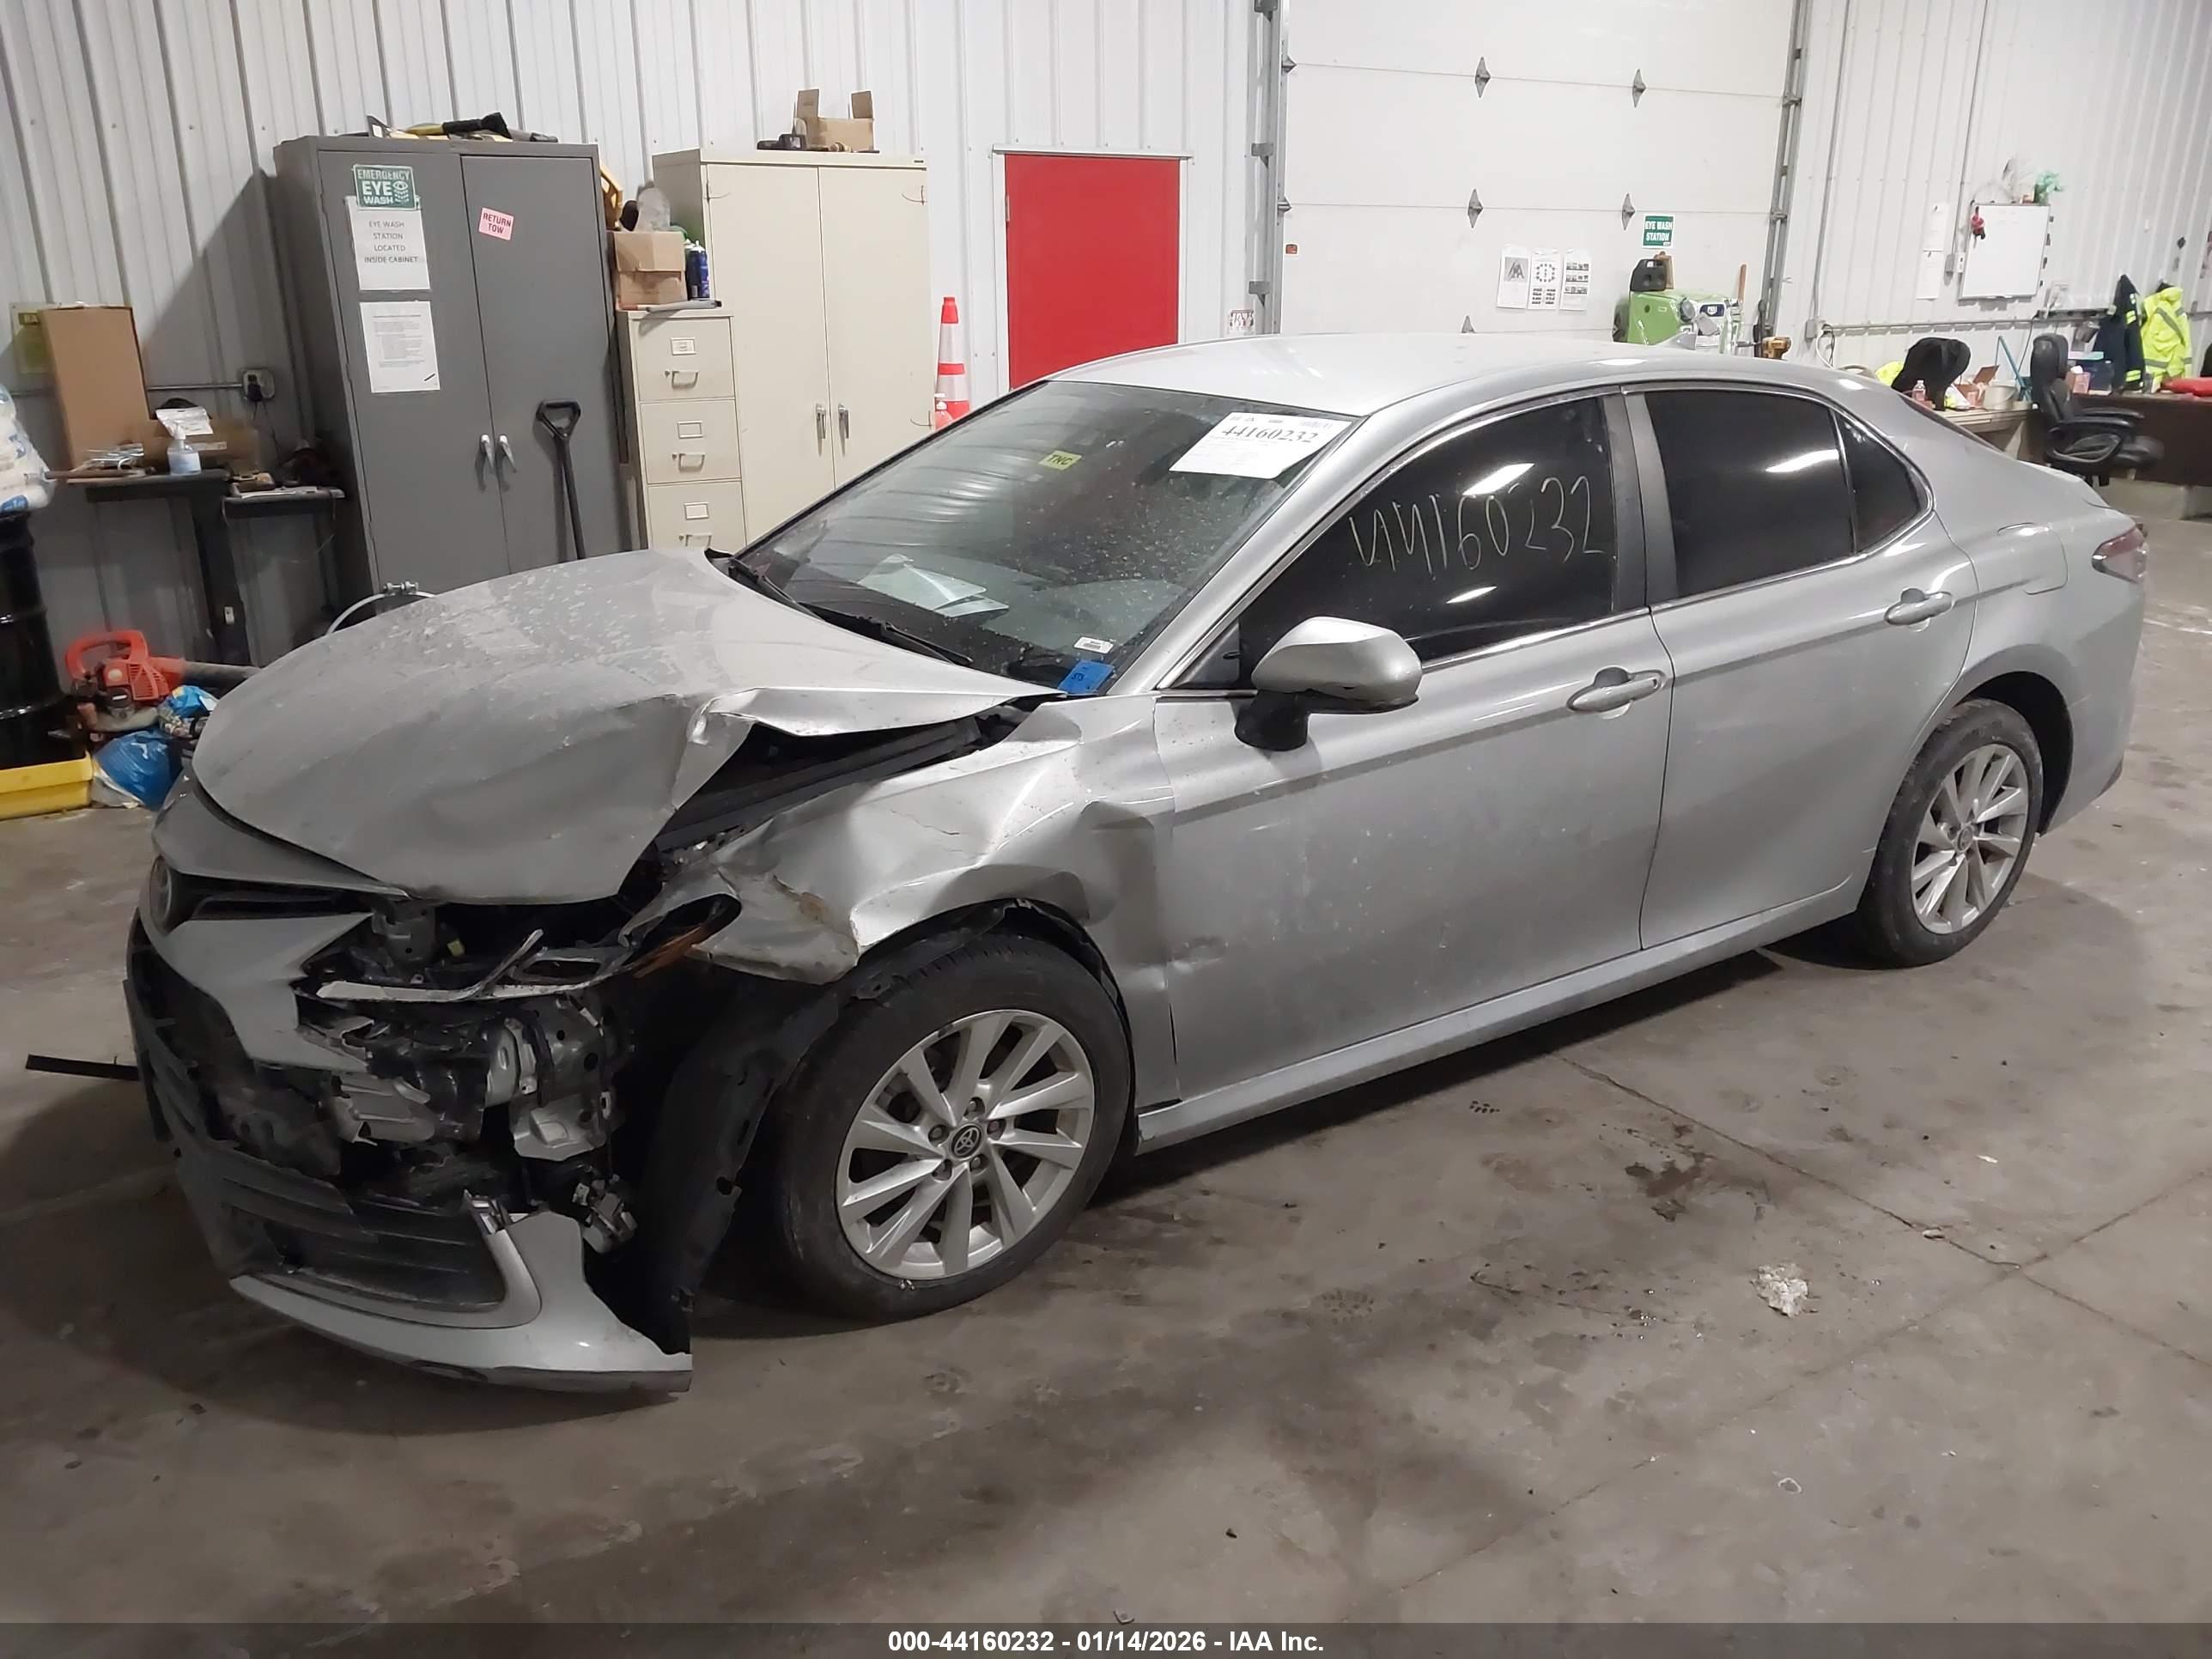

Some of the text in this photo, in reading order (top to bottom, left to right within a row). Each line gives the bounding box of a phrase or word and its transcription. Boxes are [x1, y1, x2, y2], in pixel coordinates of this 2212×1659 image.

[357, 169, 410, 180] EMERGENCY
[362, 180, 392, 196] EYE
[363, 196, 394, 204] WASH
[483, 212, 512, 228] RETURN
[1644, 221, 1673, 230] EYE WASH
[488, 222, 505, 234] TOW
[1645, 232, 1669, 241] STATION
[1221, 425, 1319, 443] 44160232
[1348, 475, 1605, 576] 44160232
